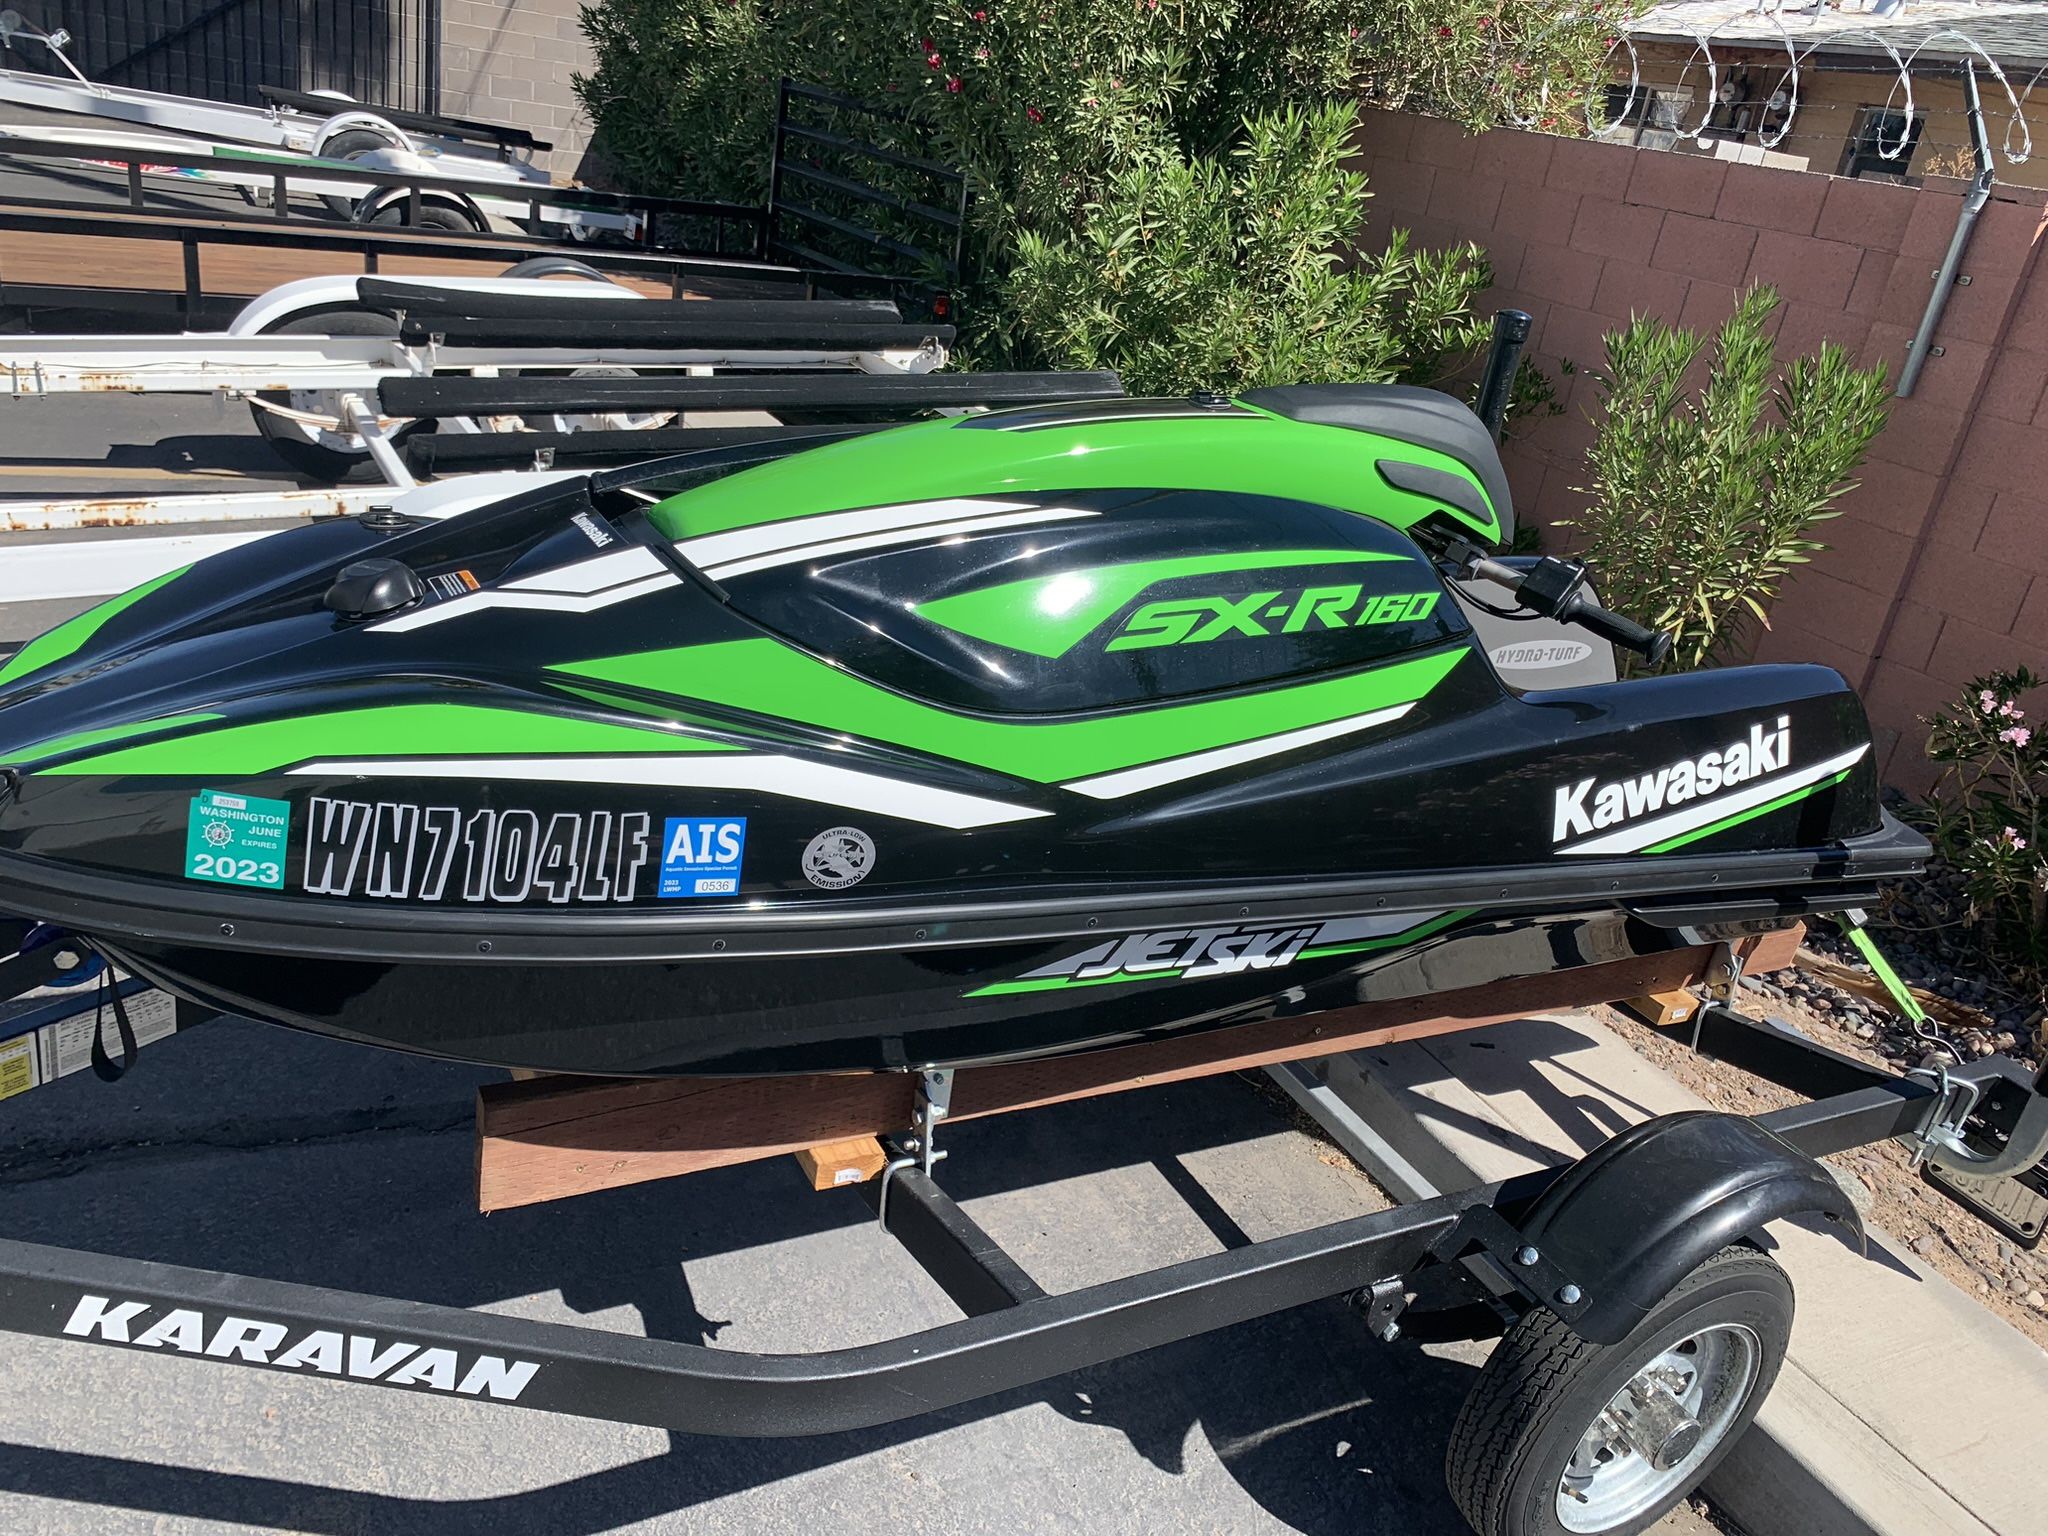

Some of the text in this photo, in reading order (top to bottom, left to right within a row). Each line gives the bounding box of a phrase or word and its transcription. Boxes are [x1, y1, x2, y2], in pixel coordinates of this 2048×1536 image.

[570, 511, 614, 548] Kawasaki
[1104, 584, 1442, 653] SX-R 160
[1496, 646, 1583, 664] HYDRO-TURF
[1552, 713, 1791, 843] Kawasaki
[200, 805, 285, 826] WASHINGTON
[241, 839, 278, 849] EXPIRES
[248, 826, 283, 838] JUNE
[665, 823, 742, 864] AIS
[822, 829, 867, 842] ULTRA-LOW
[303, 797, 651, 903] WN7104LF
[193, 853, 280, 884] 2023
[810, 873, 863, 888] EMISSION
[701, 881, 729, 892] 0536
[62, 1295, 541, 1400] KARAVAN
